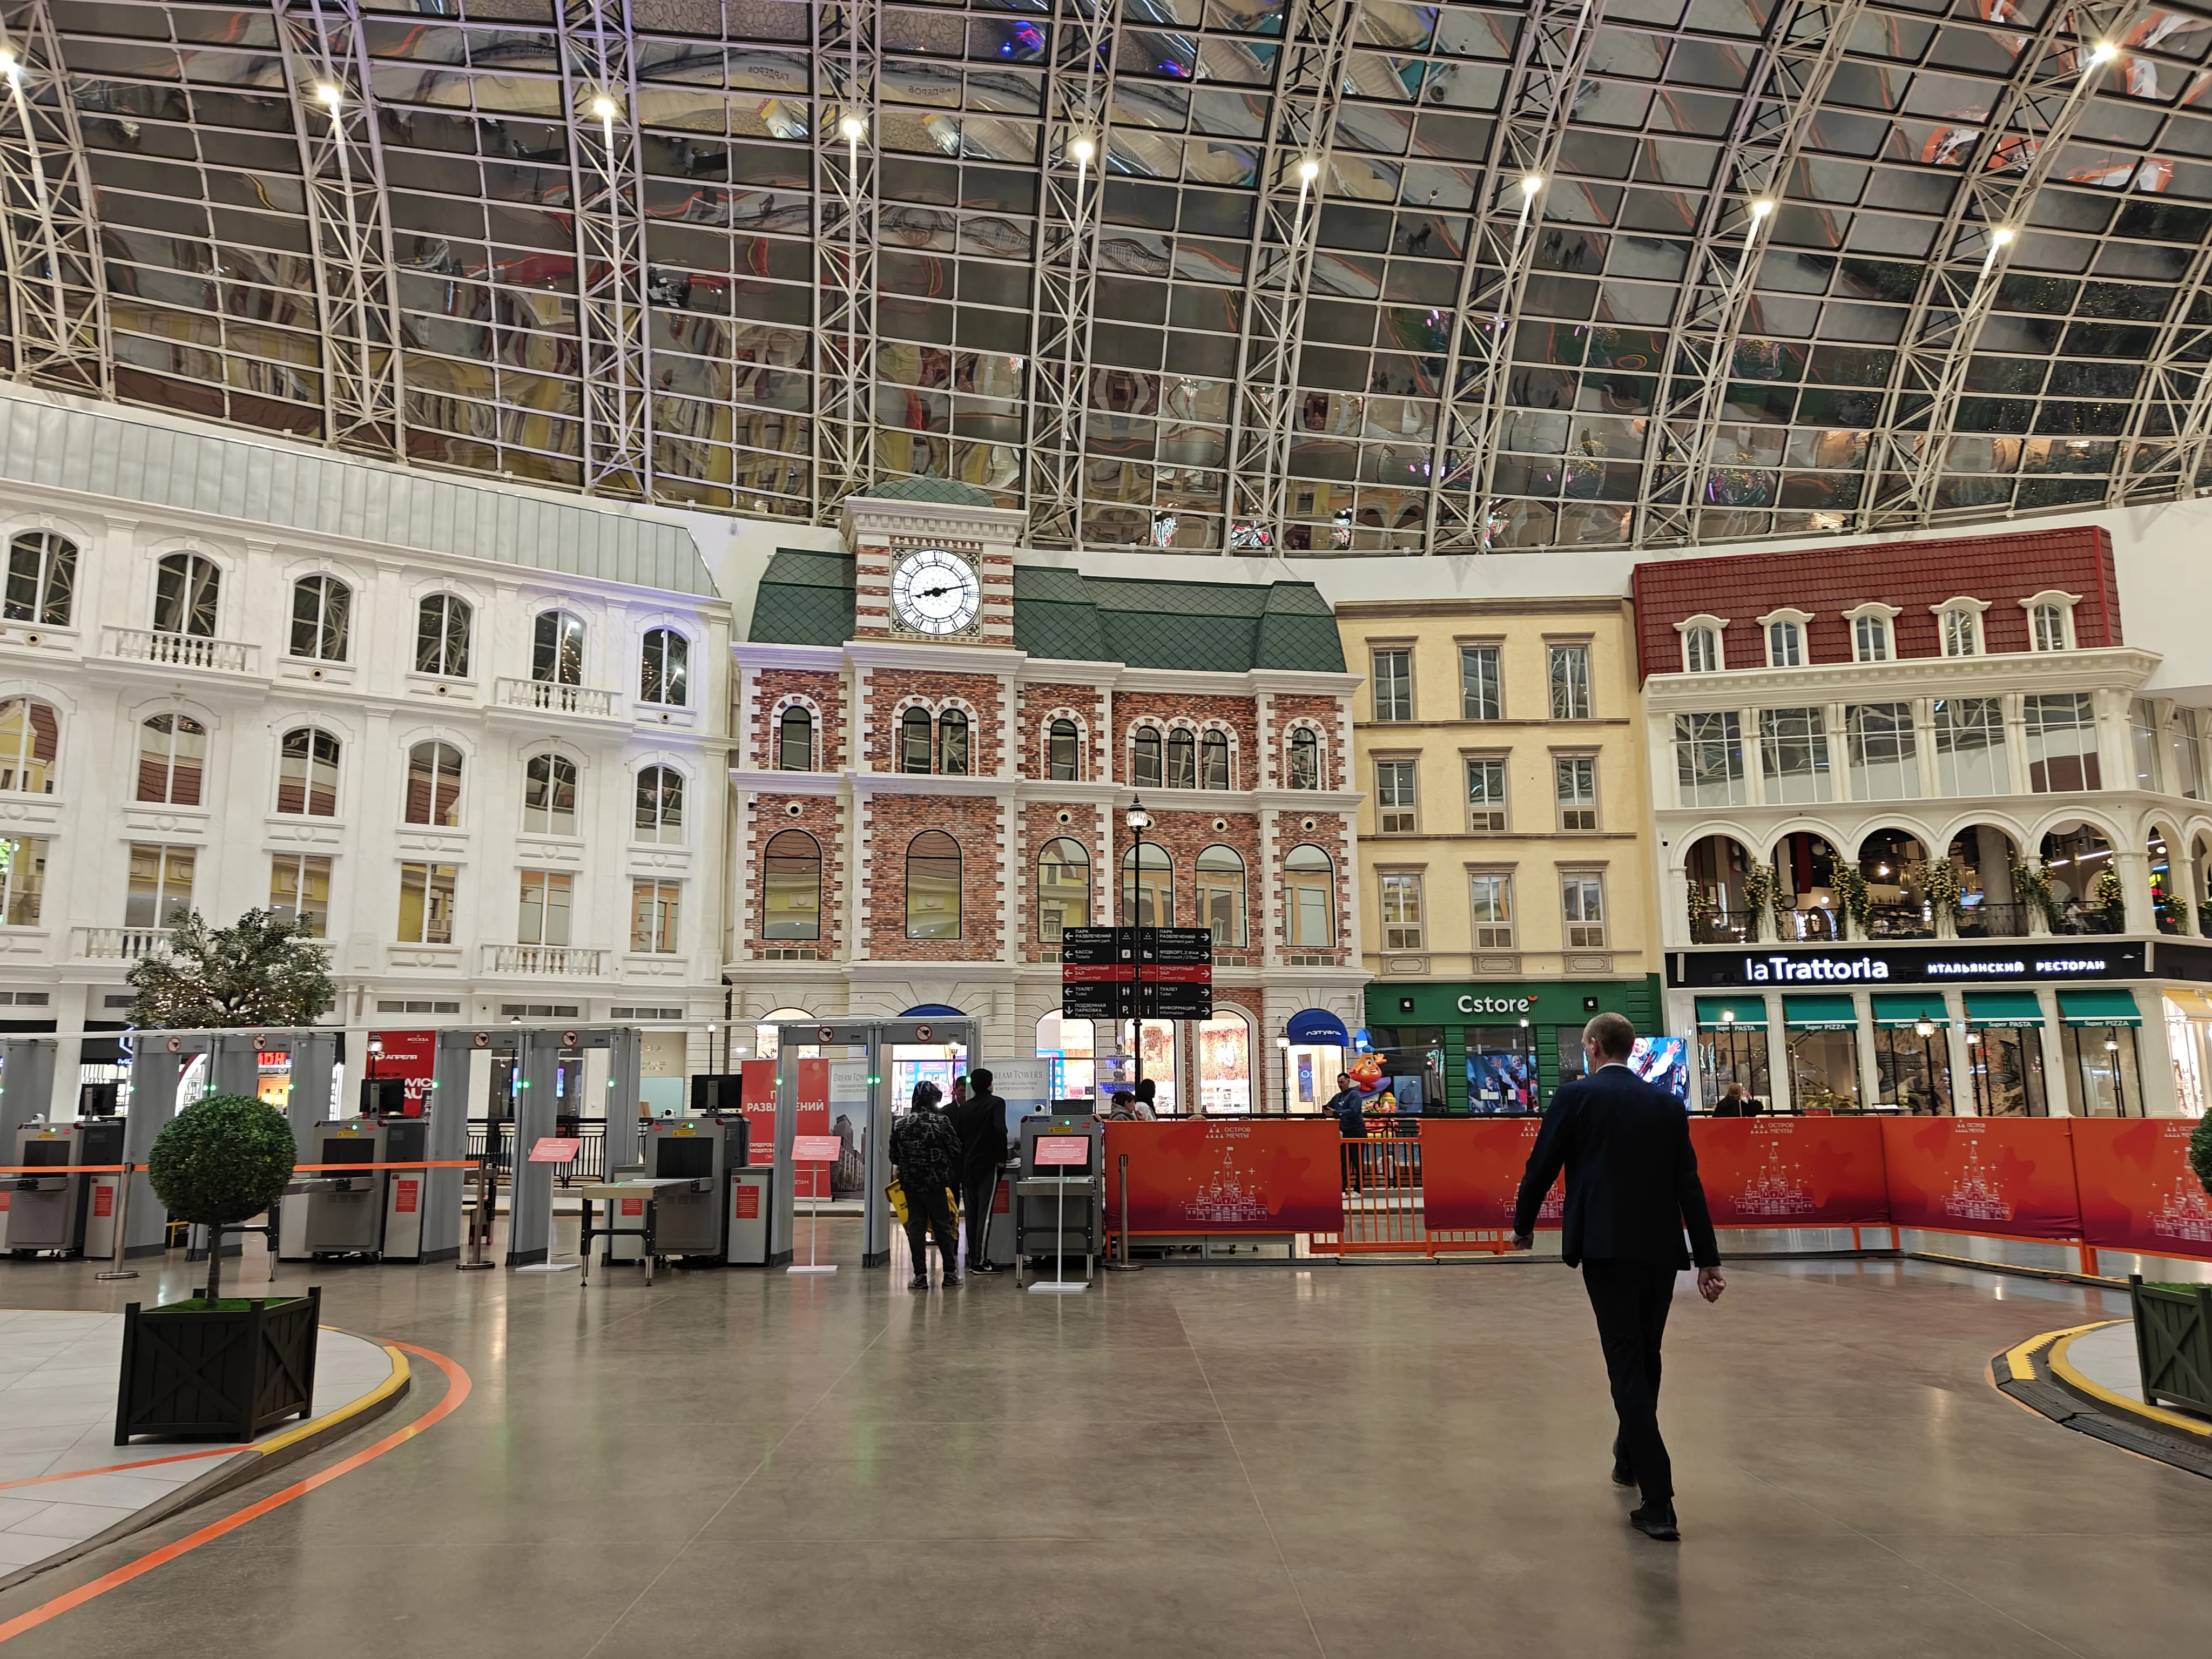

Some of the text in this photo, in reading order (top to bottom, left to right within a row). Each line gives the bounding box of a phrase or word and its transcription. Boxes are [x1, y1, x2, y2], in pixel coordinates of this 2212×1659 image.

[1927, 960, 2105, 974] ИТАЛЬЯНСКИЙ РЕСТОРАН
[1458, 995, 1529, 1013] Cstore
[1014, 1070, 1043, 1079] TOWERS
